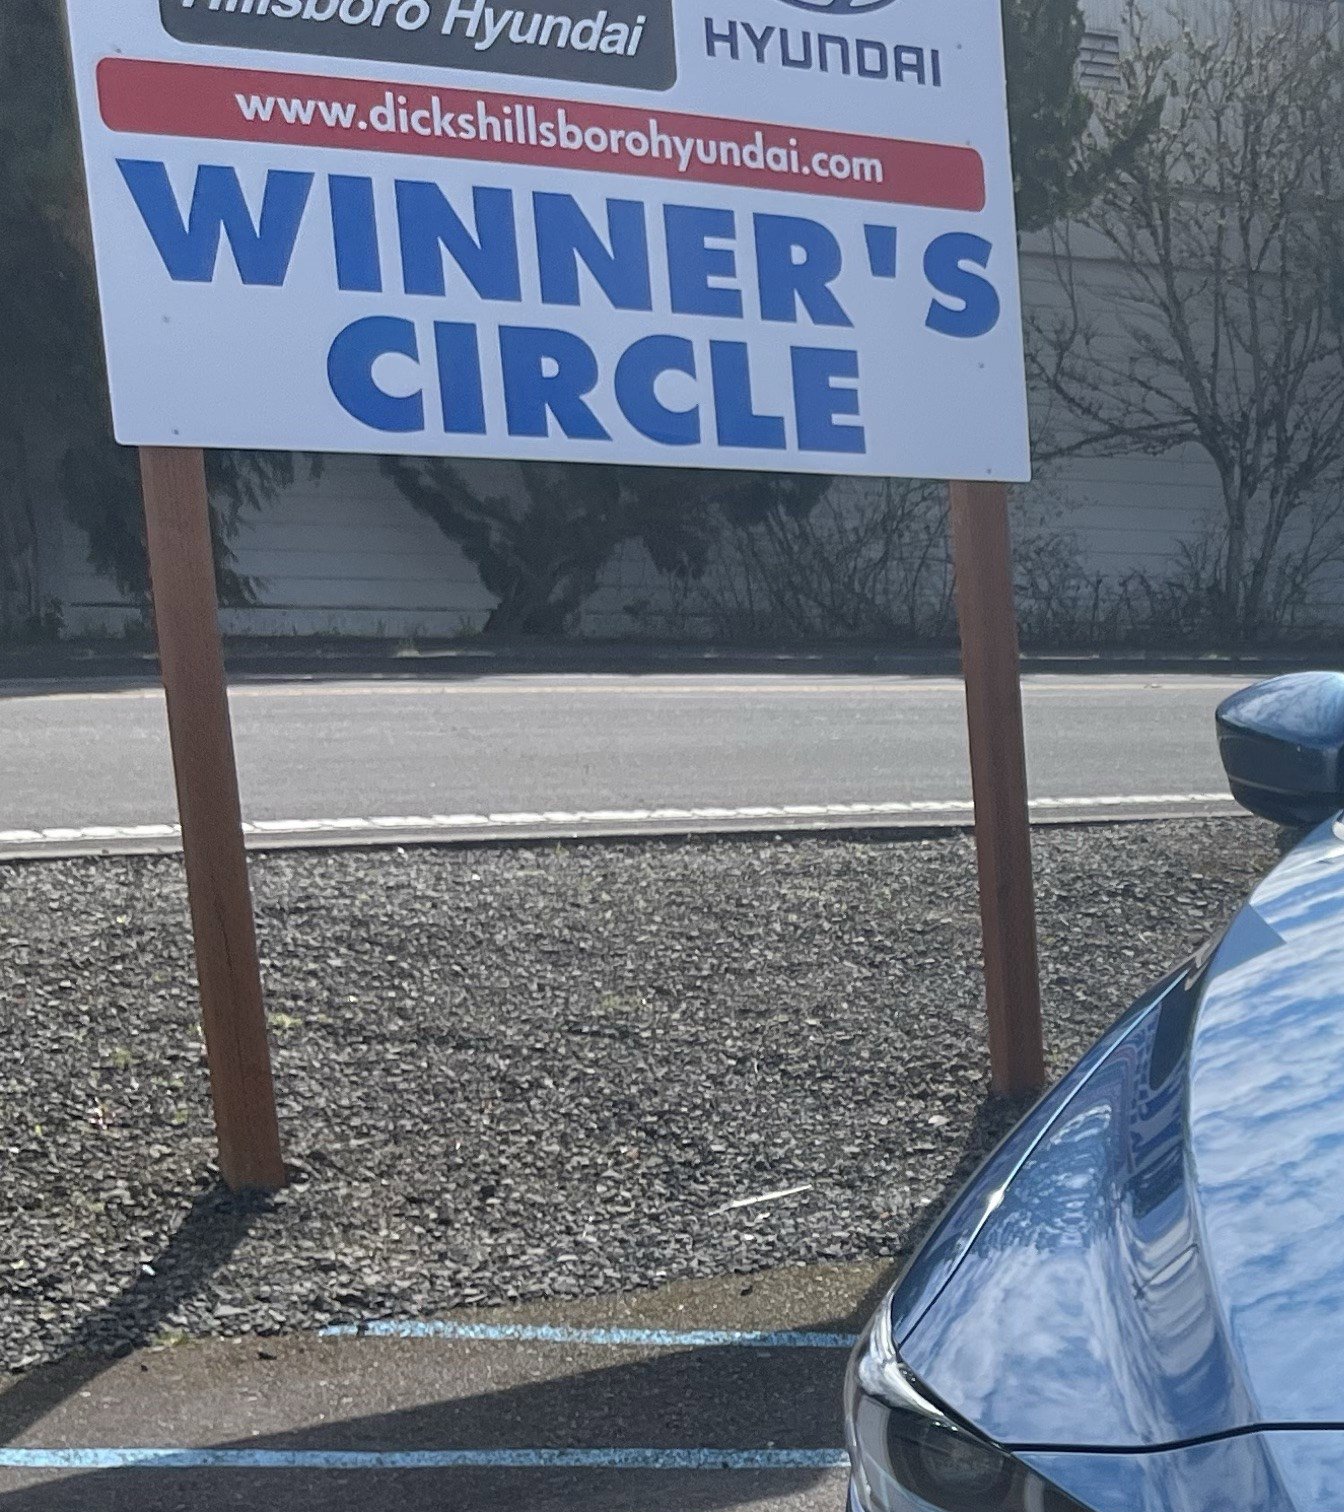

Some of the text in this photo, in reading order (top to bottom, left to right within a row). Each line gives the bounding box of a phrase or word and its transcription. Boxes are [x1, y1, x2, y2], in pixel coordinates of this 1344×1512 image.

[183, 0, 647, 56] sboro Hyundai
[704, 17, 942, 87] HYUNDAI
[234, 91, 885, 186] www.dickshillsborohyundai.com
[114, 158, 1002, 339] WINNER'S
[326, 315, 868, 455] CIRCLE
